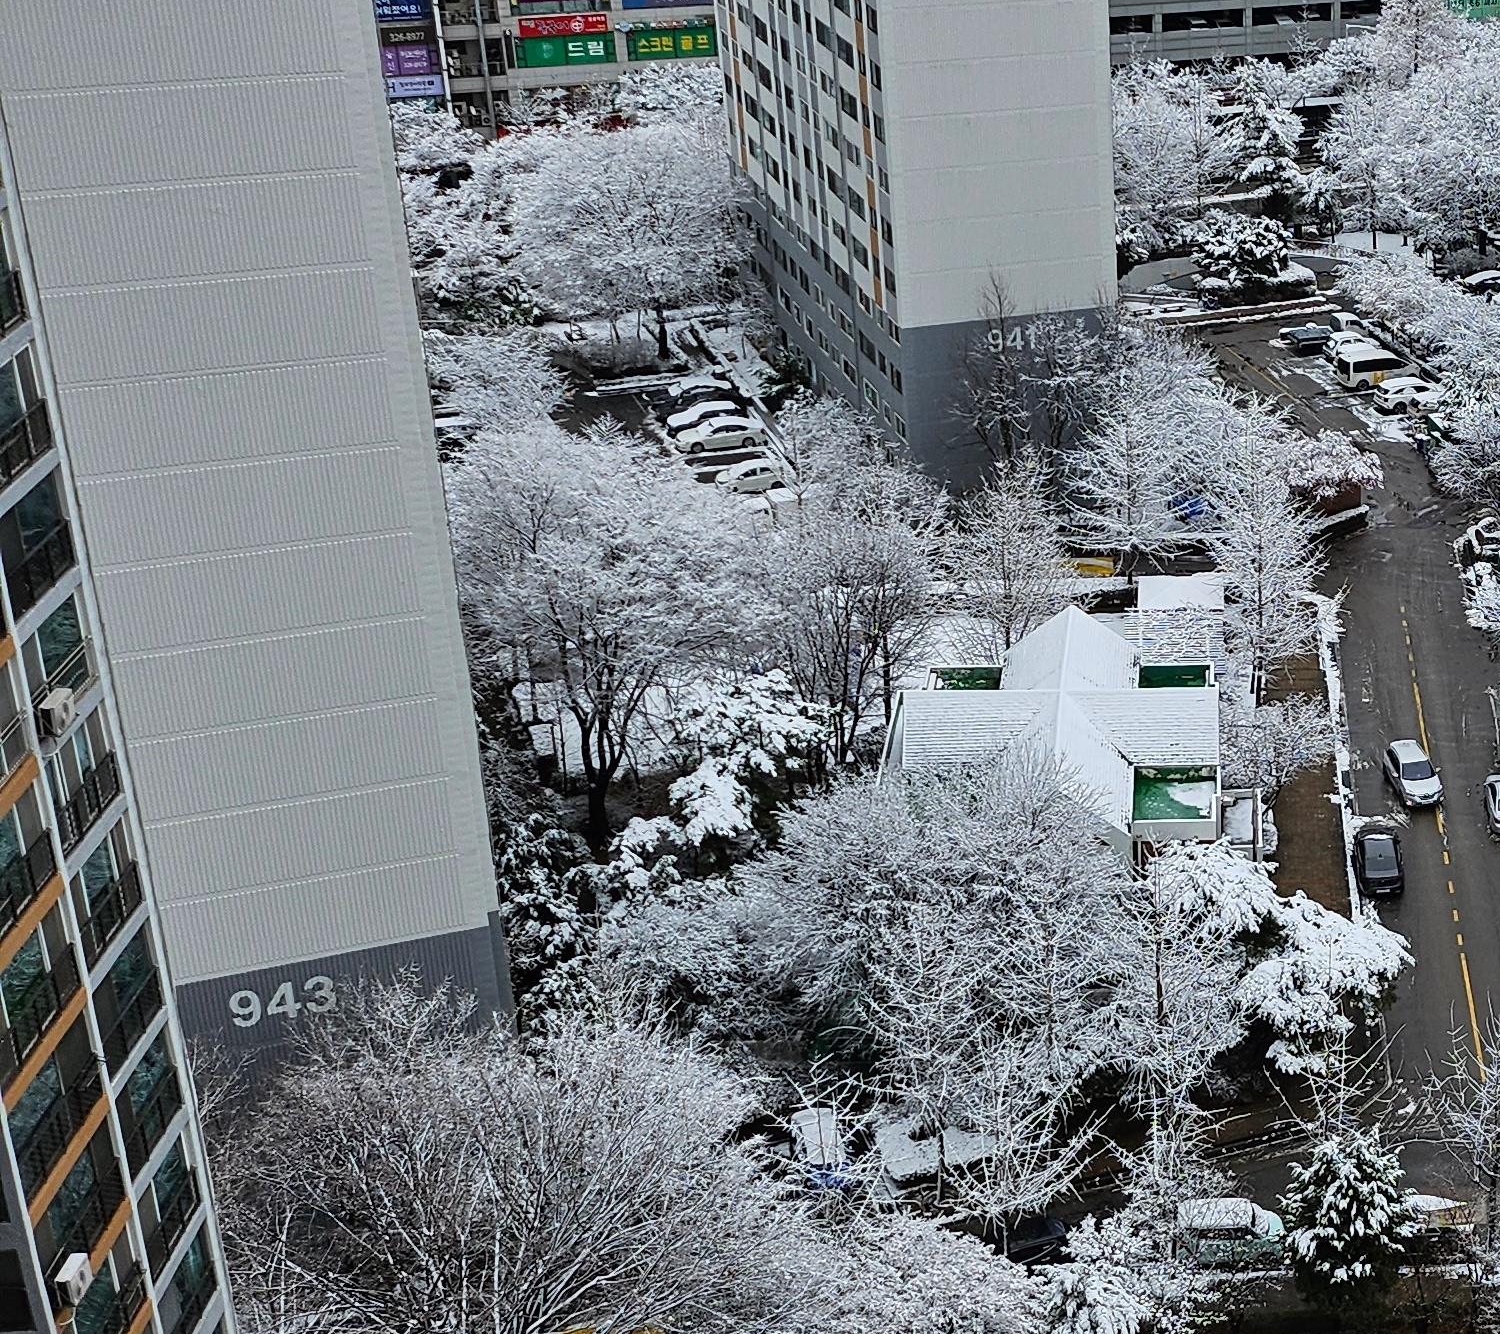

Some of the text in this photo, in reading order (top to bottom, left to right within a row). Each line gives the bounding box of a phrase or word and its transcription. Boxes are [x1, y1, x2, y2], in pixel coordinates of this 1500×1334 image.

[568, 40, 605, 56] 드림
[638, 35, 710, 52] 스크린 골프
[229, 975, 338, 1028] 943
